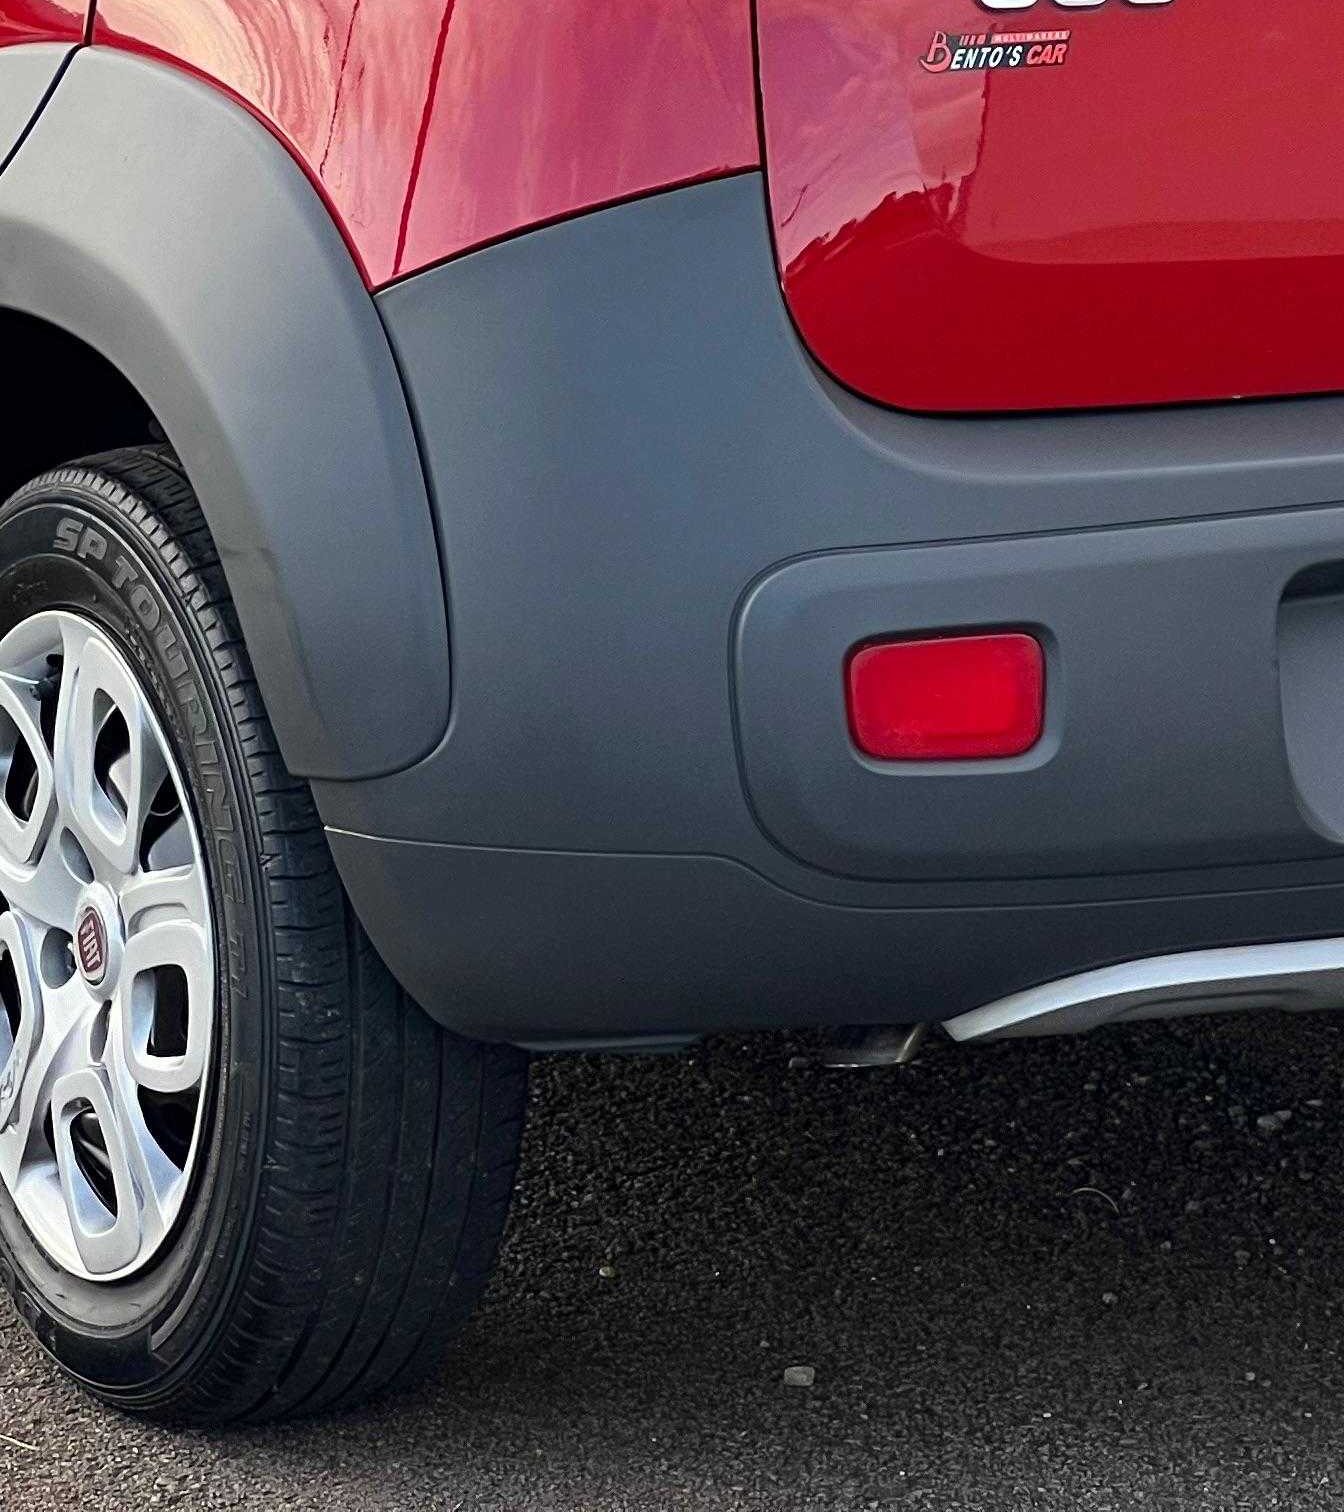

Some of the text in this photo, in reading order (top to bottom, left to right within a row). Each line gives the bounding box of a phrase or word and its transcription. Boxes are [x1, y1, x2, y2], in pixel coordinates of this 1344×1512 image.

[1026, 44, 1067, 65] CAR
[53, 517, 107, 561] SP
[80, 919, 101, 968] FIAT
